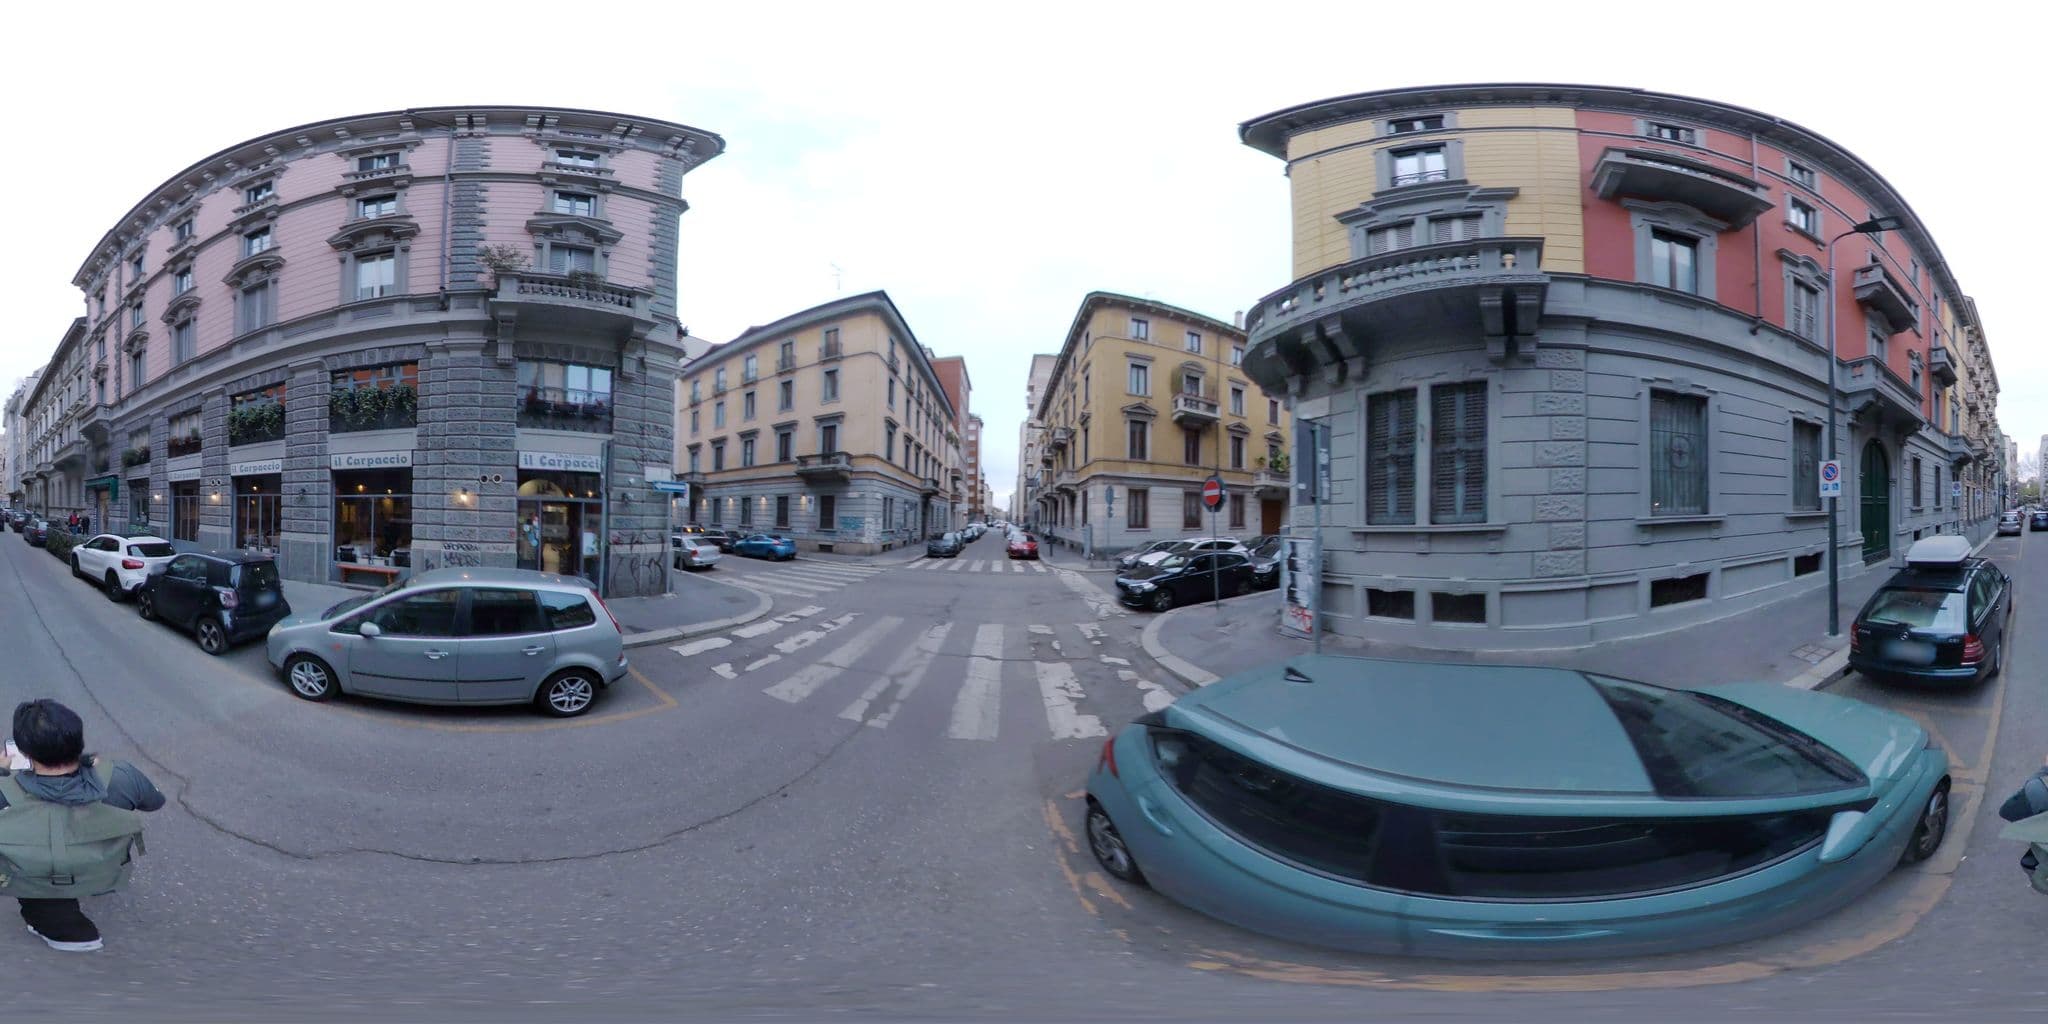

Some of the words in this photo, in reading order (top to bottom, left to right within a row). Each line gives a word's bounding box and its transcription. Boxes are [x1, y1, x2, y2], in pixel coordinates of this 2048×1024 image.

[240, 461, 280, 473] Carpaccio
[334, 455, 342, 467] il
[346, 454, 408, 467] Carpaccio
[523, 454, 533, 466] il
[540, 455, 600, 470] Carpacci
